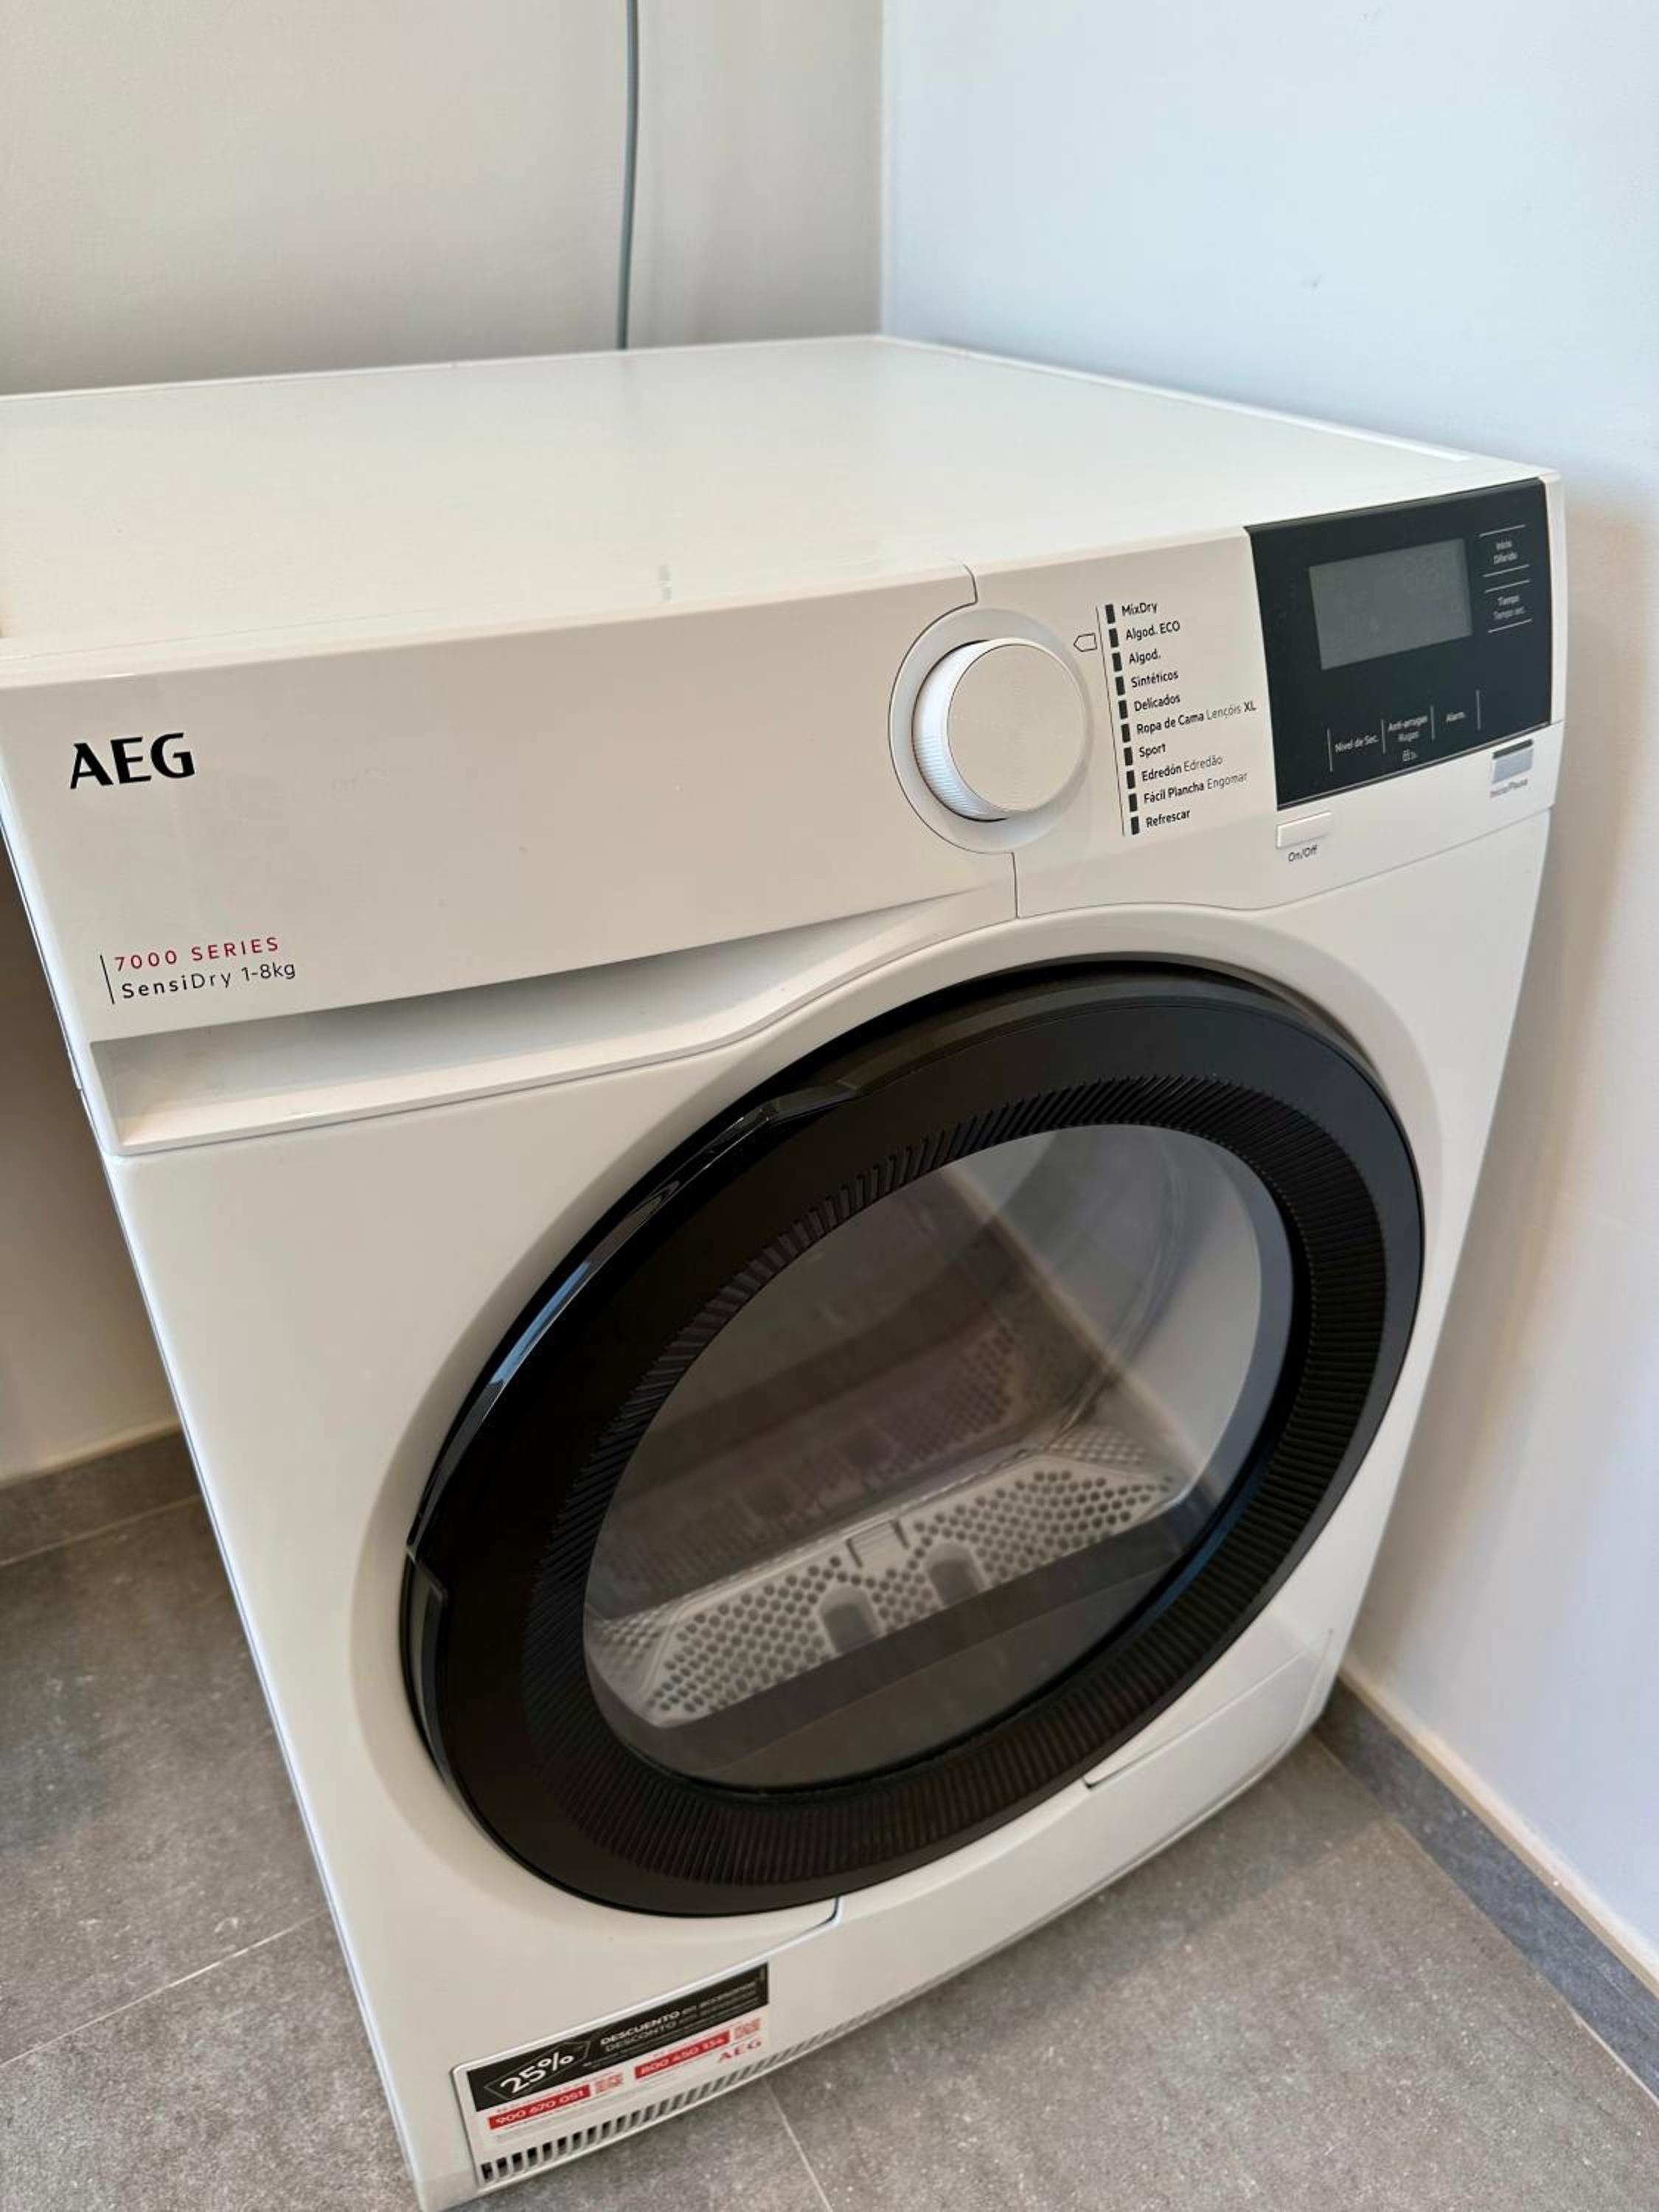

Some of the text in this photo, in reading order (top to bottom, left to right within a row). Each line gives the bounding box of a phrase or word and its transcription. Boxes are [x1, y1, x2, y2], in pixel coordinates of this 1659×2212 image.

[1121, 602, 1158, 616] MixDry
[1126, 620, 1180, 641] Algod. ECO
[1129, 649, 1161, 665] Algod.
[1131, 671, 1179, 688] Sintéticos
[1134, 695, 1180, 712] Delicados
[1137, 701, 1256, 735] Ropa de Cama Lençóis XL
[1139, 743, 1166, 758] Sport
[1335, 740, 1353, 752] Nivel
[70, 732, 195, 790] AEG
[1142, 755, 1223, 782] Edredón Edredão
[1144, 772, 1248, 804] Fácil Plancha Engomar
[1146, 810, 1191, 827] Refrescar
[1288, 844, 1318, 861] On/Off
[114, 937, 279, 972] 7000 SERIES
[122, 962, 296, 1000] SensiDry 1-8kg
[600, 2009, 681, 2045] DESCUENTO
[605, 2020, 677, 2053] DESCONTO
[719, 2040, 761, 2062] AEG
[500, 2052, 574, 2093] 25%
[495, 2110, 527, 2124] 900
